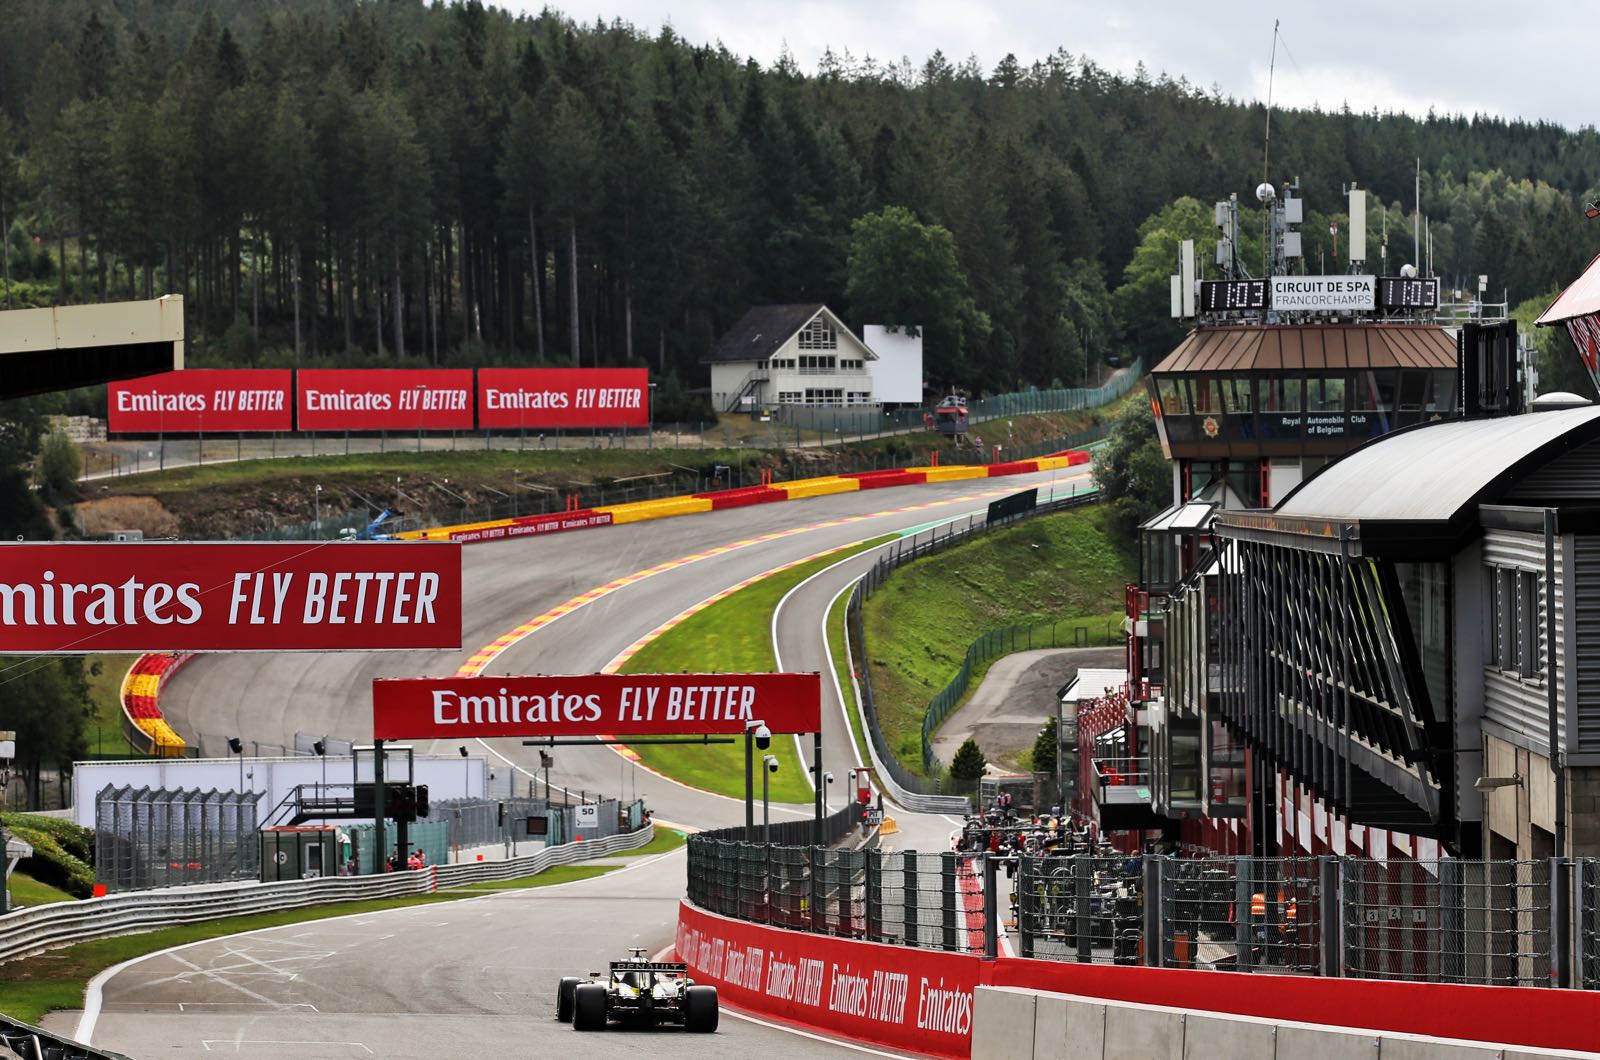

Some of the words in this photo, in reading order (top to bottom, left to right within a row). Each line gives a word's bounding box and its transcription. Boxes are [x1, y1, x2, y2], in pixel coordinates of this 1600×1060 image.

[1210, 282, 1264, 308] 11:03
[1275, 282, 1324, 293] CIRCUIT
[1327, 282, 1343, 293] DE
[1347, 281, 1371, 292] SPA
[1388, 280, 1435, 306] 11:03
[1275, 295, 1372, 305] FRANCORCHAMPS
[116, 389, 207, 412] Emirates
[213, 390, 236, 411] FLY
[238, 390, 285, 411] BETTER
[305, 389, 392, 411] Emirates
[398, 389, 421, 410] FLY
[422, 389, 467, 410] BETTER
[486, 388, 569, 409] Emirates
[575, 388, 597, 409] FLY
[598, 388, 641, 408] BETTER
[1282, 417, 1301, 427] Royal
[1307, 416, 1344, 425] Automobile
[1350, 415, 1366, 423] Club
[1316, 425, 1344, 435] Belgium
[228, 572, 293, 625] FLY
[303, 572, 440, 624] BETTER
[432, 687, 602, 725] Emirates
[618, 687, 660, 721] FLY
[666, 686, 756, 721] BETTER
[1391, 908, 1398, 918] 2
[828, 963, 869, 1017] Emirates
[868, 969, 885, 1020] FLY
[880, 971, 909, 1024] BETTER
[917, 976, 973, 1035] Emirates
